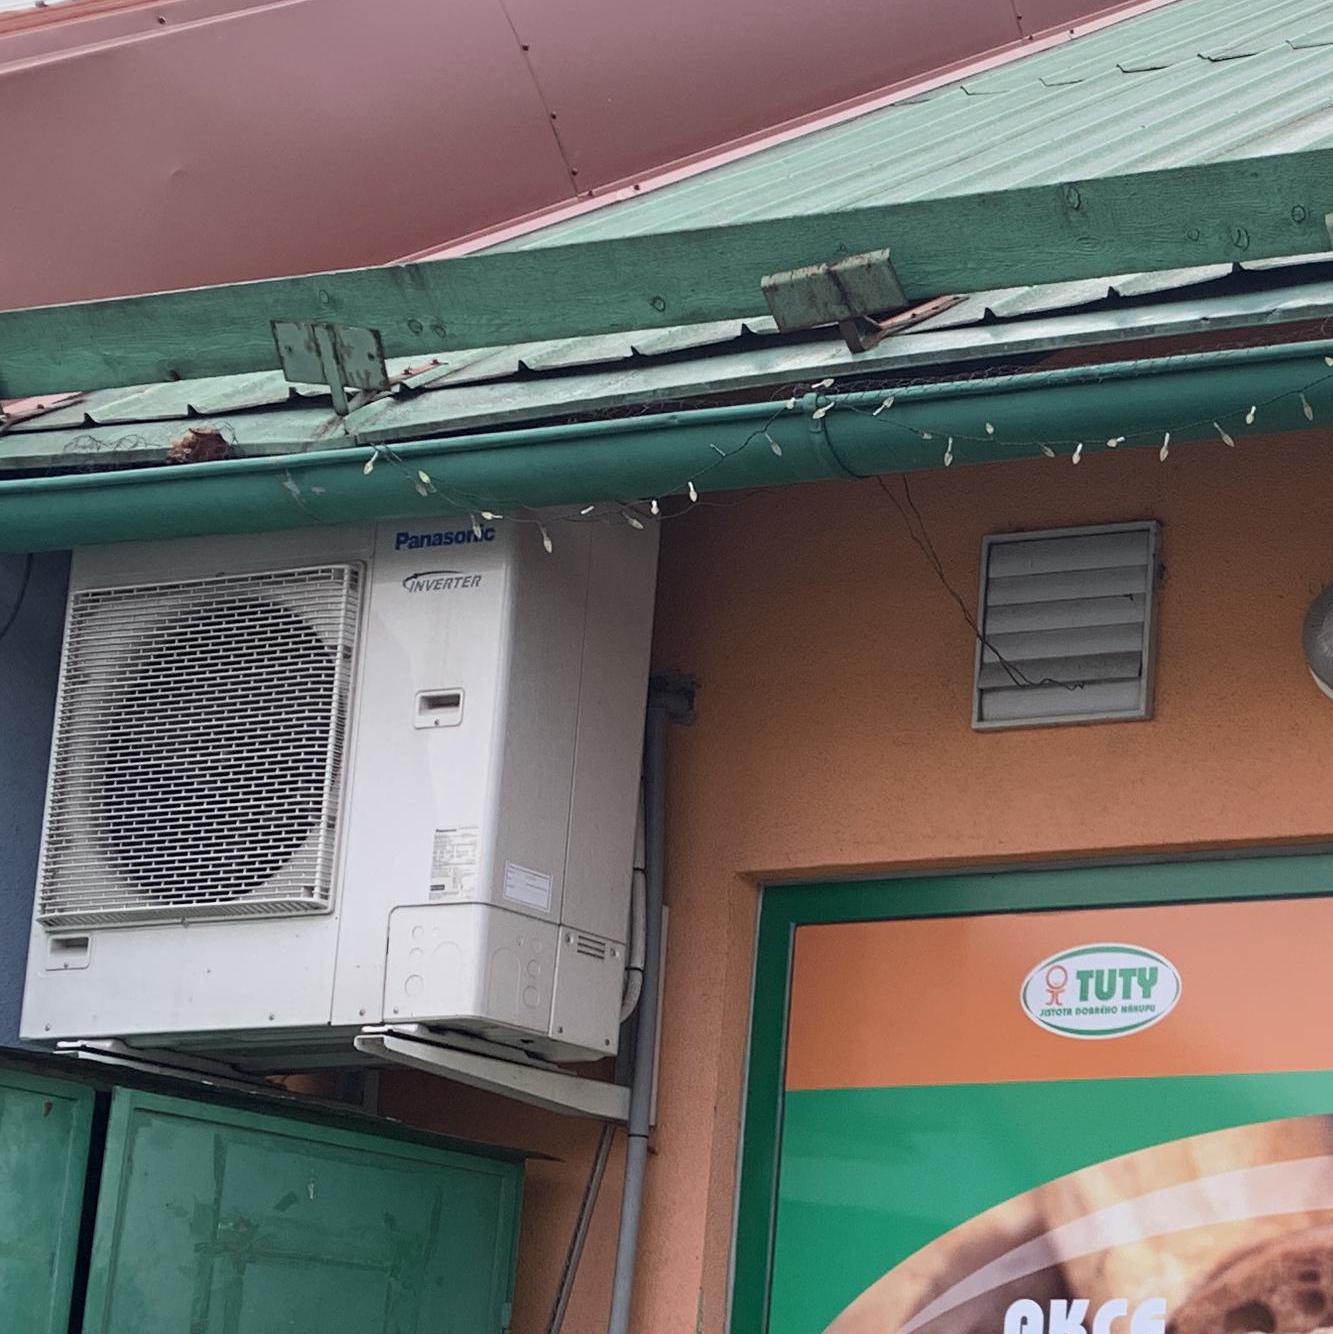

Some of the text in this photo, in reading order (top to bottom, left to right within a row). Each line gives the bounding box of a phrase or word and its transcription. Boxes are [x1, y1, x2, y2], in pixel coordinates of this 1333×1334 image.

[394, 523, 496, 551] Panasonic
[409, 575, 482, 593] INVERTER
[1076, 966, 1159, 1003] TUTY
